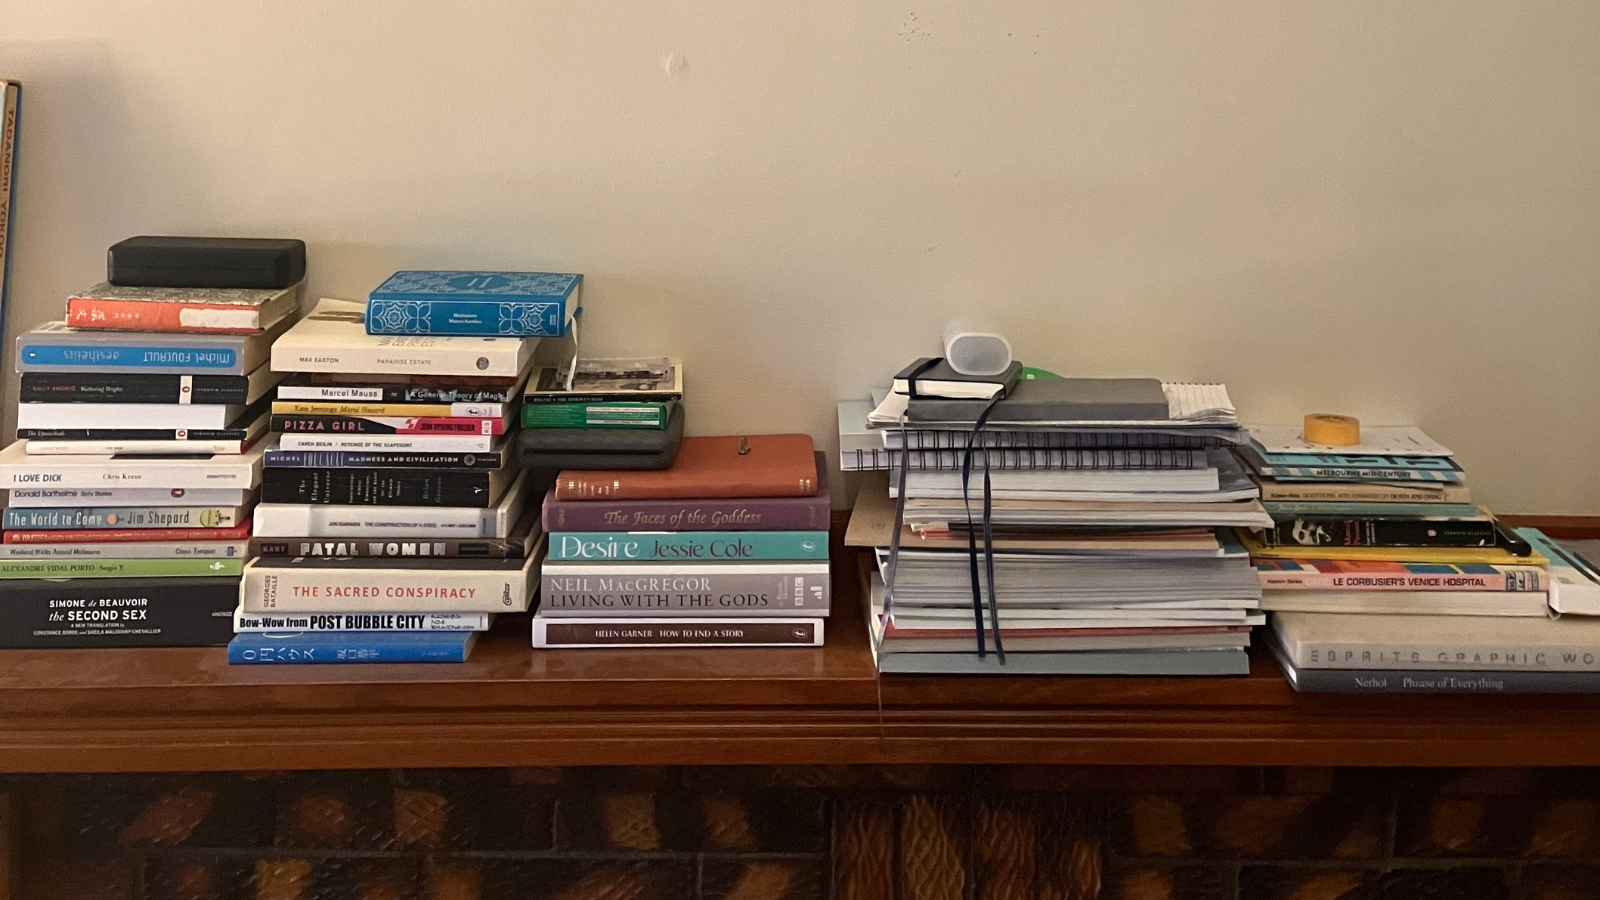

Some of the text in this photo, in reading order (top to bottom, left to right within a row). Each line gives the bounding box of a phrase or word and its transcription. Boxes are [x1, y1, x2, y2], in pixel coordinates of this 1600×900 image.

[3, 110, 14, 192] TADANORI
[63, 350, 230, 364] Michel FOUCAULT aesthetics
[321, 389, 378, 398] Marcel Mauss
[410, 391, 417, 399] A
[449, 391, 472, 402] Theory
[473, 391, 481, 400] of
[309, 405, 338, 413] Jennings
[284, 420, 365, 431] PIZZA GIRL
[13, 474, 62, 483] I LOVE DICK
[311, 472, 319, 501] Elegant
[14, 490, 40, 498] Donald
[81, 490, 94, 498] Sixty
[9, 511, 190, 526] The World to Come Jim Shepard
[604, 510, 761, 527] The Faces of the Goddess
[300, 543, 359, 555] FATAL
[368, 543, 446, 556] WOMEN
[560, 536, 753, 558] Desire Jessie Cole
[1, 565, 46, 573] ALEXANDRE
[46, 564, 69, 572] VIDAL
[70, 564, 95, 572] PORTO
[550, 578, 592, 592] NEIL
[1333, 577, 1344, 587] LE
[1346, 577, 1406, 587] CORBUSIER'S
[1407, 577, 1441, 587] VENICE
[1443, 577, 1487, 587] HOSPITAL
[263, 575, 271, 608] GEORGES
[270, 575, 278, 608] BATAILLE
[293, 586, 476, 599] THE SACRED CONSPIRACY
[794, 577, 804, 606] BBC
[49, 598, 148, 608] SIMONE de BEAUVOIR
[550, 593, 769, 607] LIVING WITH THE GODS
[48, 609, 147, 622] the SECOND SEX
[239, 616, 284, 629] Bow-Wow
[286, 617, 308, 629] from
[310, 616, 343, 630] POST
[345, 615, 394, 629] BUBBLE
[396, 615, 425, 629] CITY
[595, 630, 744, 638] HELEN GARNER HOW TO END A STORY
[1311, 650, 1595, 666] ESPRITS GRAPHIC WO
[1355, 677, 1504, 691] Nerhol Phrase of Everything
